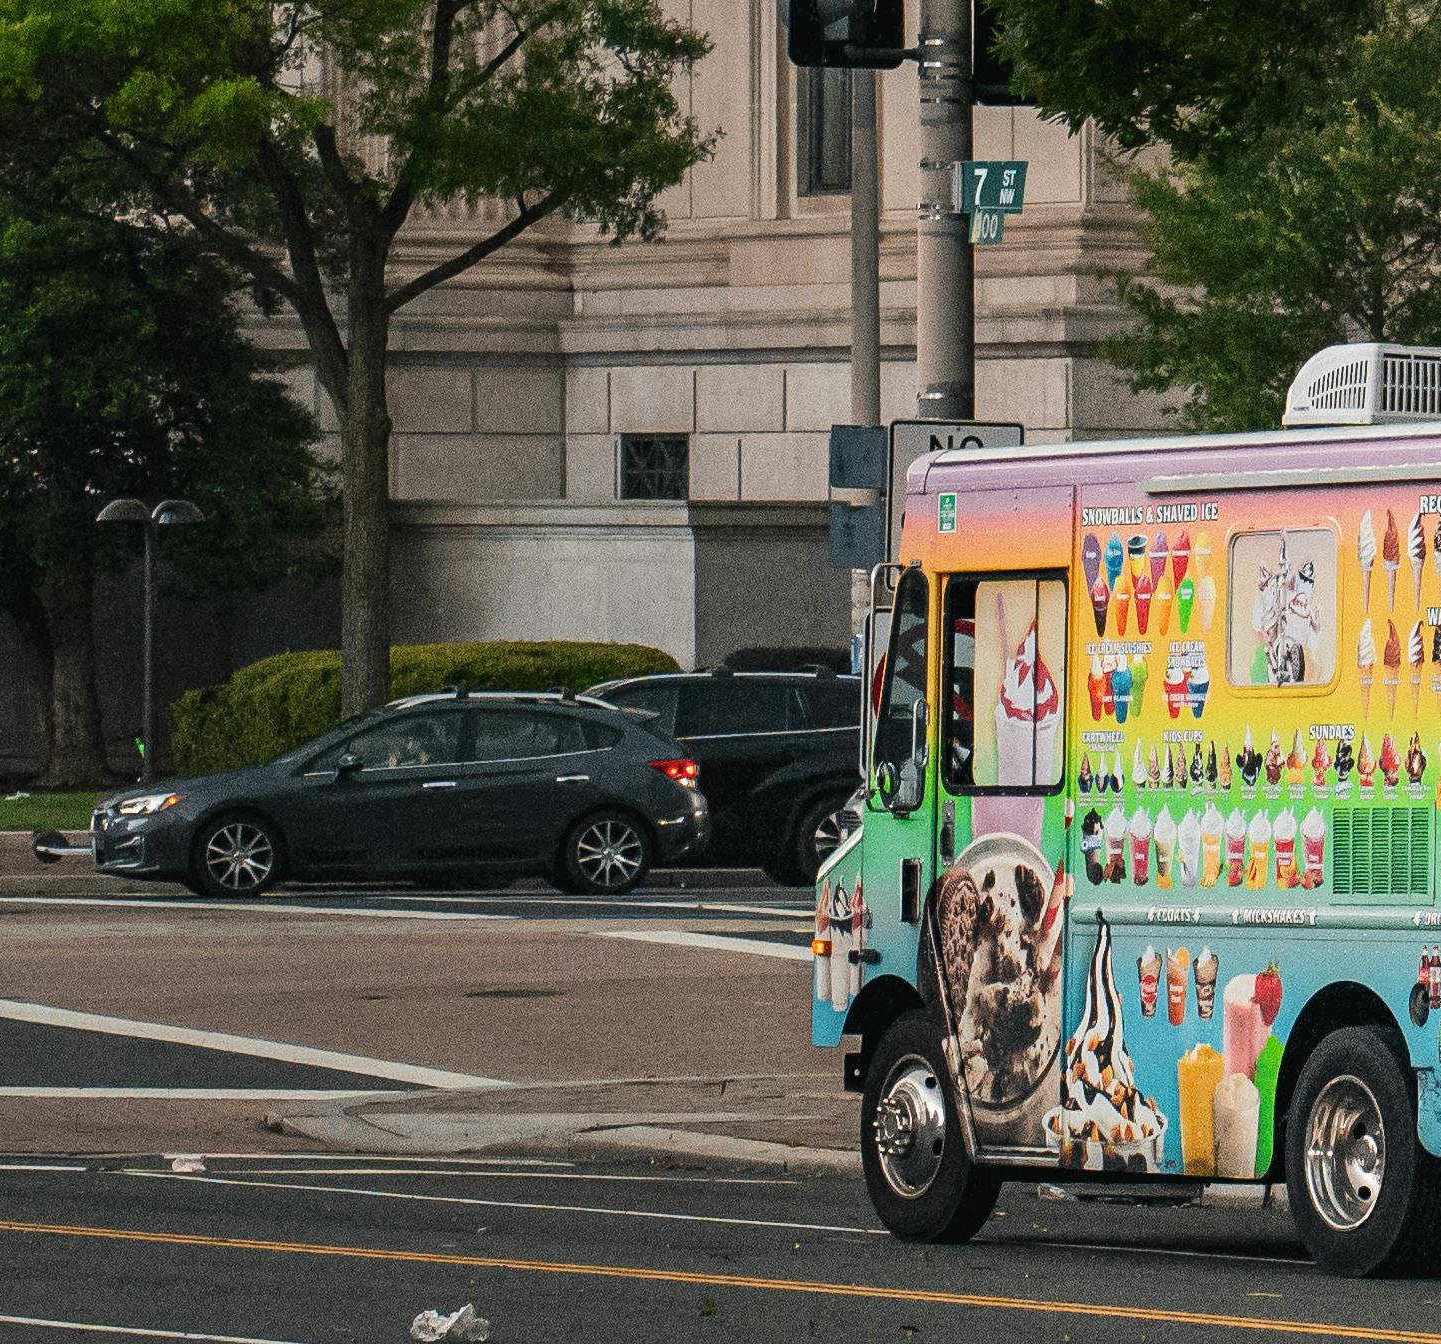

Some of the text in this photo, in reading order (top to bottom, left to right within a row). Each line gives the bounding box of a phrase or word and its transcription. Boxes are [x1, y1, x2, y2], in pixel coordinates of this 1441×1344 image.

[1002, 169, 1017, 187] ST
[974, 168, 988, 206] 7
[999, 188, 1016, 205] NW
[1082, 502, 1219, 526] SNOWBALLS & SHAVED ICE
[1082, 731, 1125, 744] CARTWHEEL
[1163, 730, 1204, 743] KIDS CUPS
[1309, 724, 1355, 741] SUNDAES
[1157, 908, 1192, 923] FLOATS
[1242, 908, 1305, 925] MILKSHAKES
